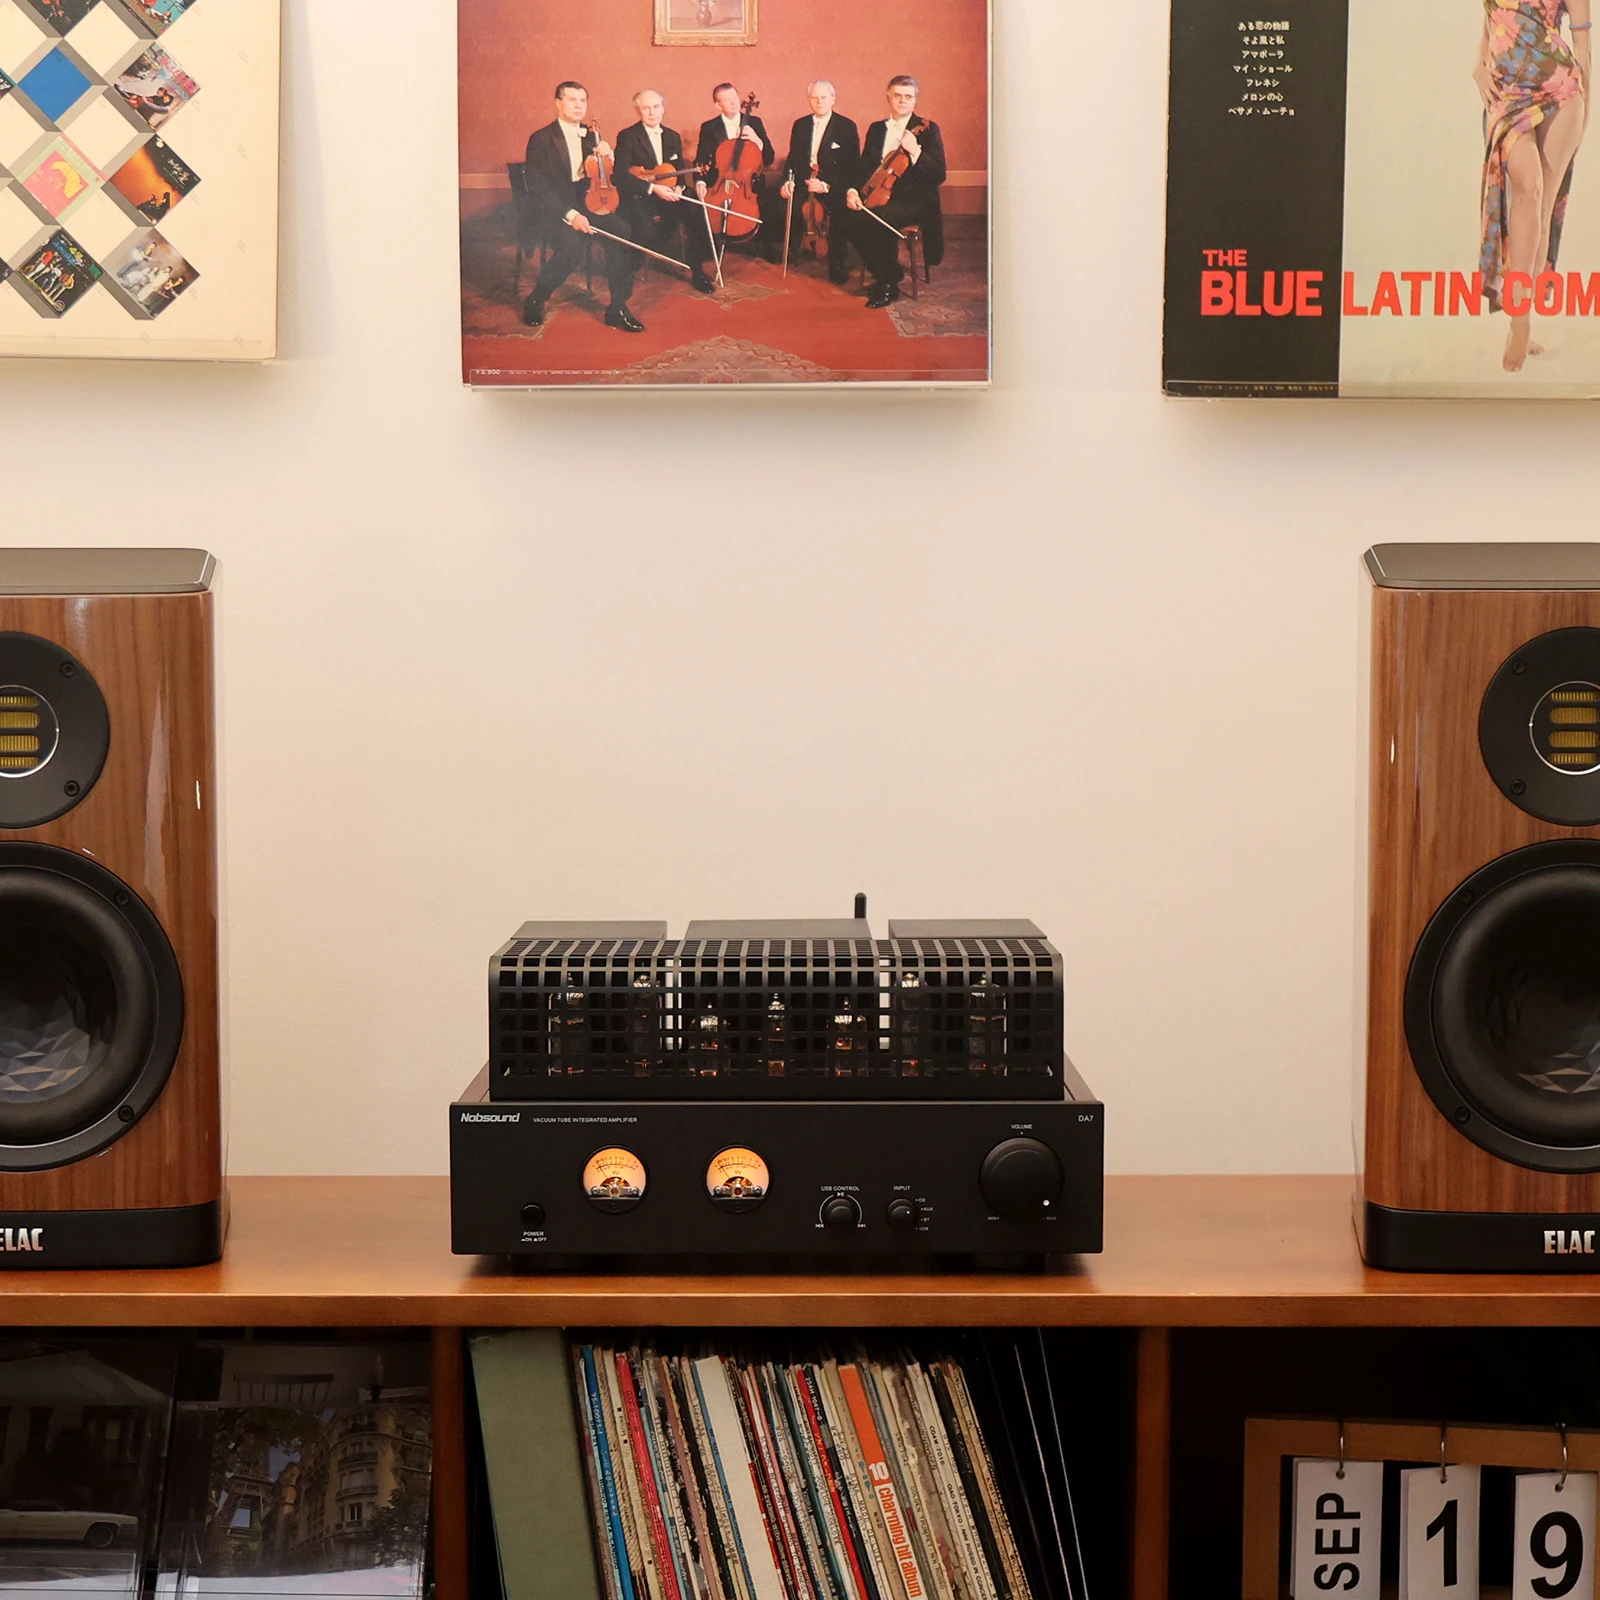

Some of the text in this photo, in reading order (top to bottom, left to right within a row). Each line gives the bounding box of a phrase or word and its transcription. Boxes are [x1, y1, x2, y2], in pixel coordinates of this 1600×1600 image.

[1202, 249, 1248, 267] THE
[1200, 269, 1600, 317] BLUE LATIN COM
[460, 1112, 521, 1123] Nobsound
[1078, 1114, 1095, 1122] DA7
[1543, 1230, 1596, 1254] ELAC
[869, 1461, 889, 1481] 10
[878, 1485, 906, 1546] charming
[910, 1484, 921, 1513] GOLDEN
[919, 1515, 932, 1548] TRUMPET
[946, 1483, 955, 1499] CIAO
[952, 1500, 963, 1524] TOKYO
[965, 1542, 976, 1566] ROSSO
[764, 1493, 776, 1523] EVENING
[772, 1523, 780, 1541] WITH
[777, 1540, 785, 1559] JOHN
[782, 1559, 792, 1585] DENVER
[896, 1542, 912, 1562] hit
[1313, 1492, 1361, 1591] SEP
[1426, 1498, 1584, 1600] 1 9
[900, 1558, 922, 1598] album
